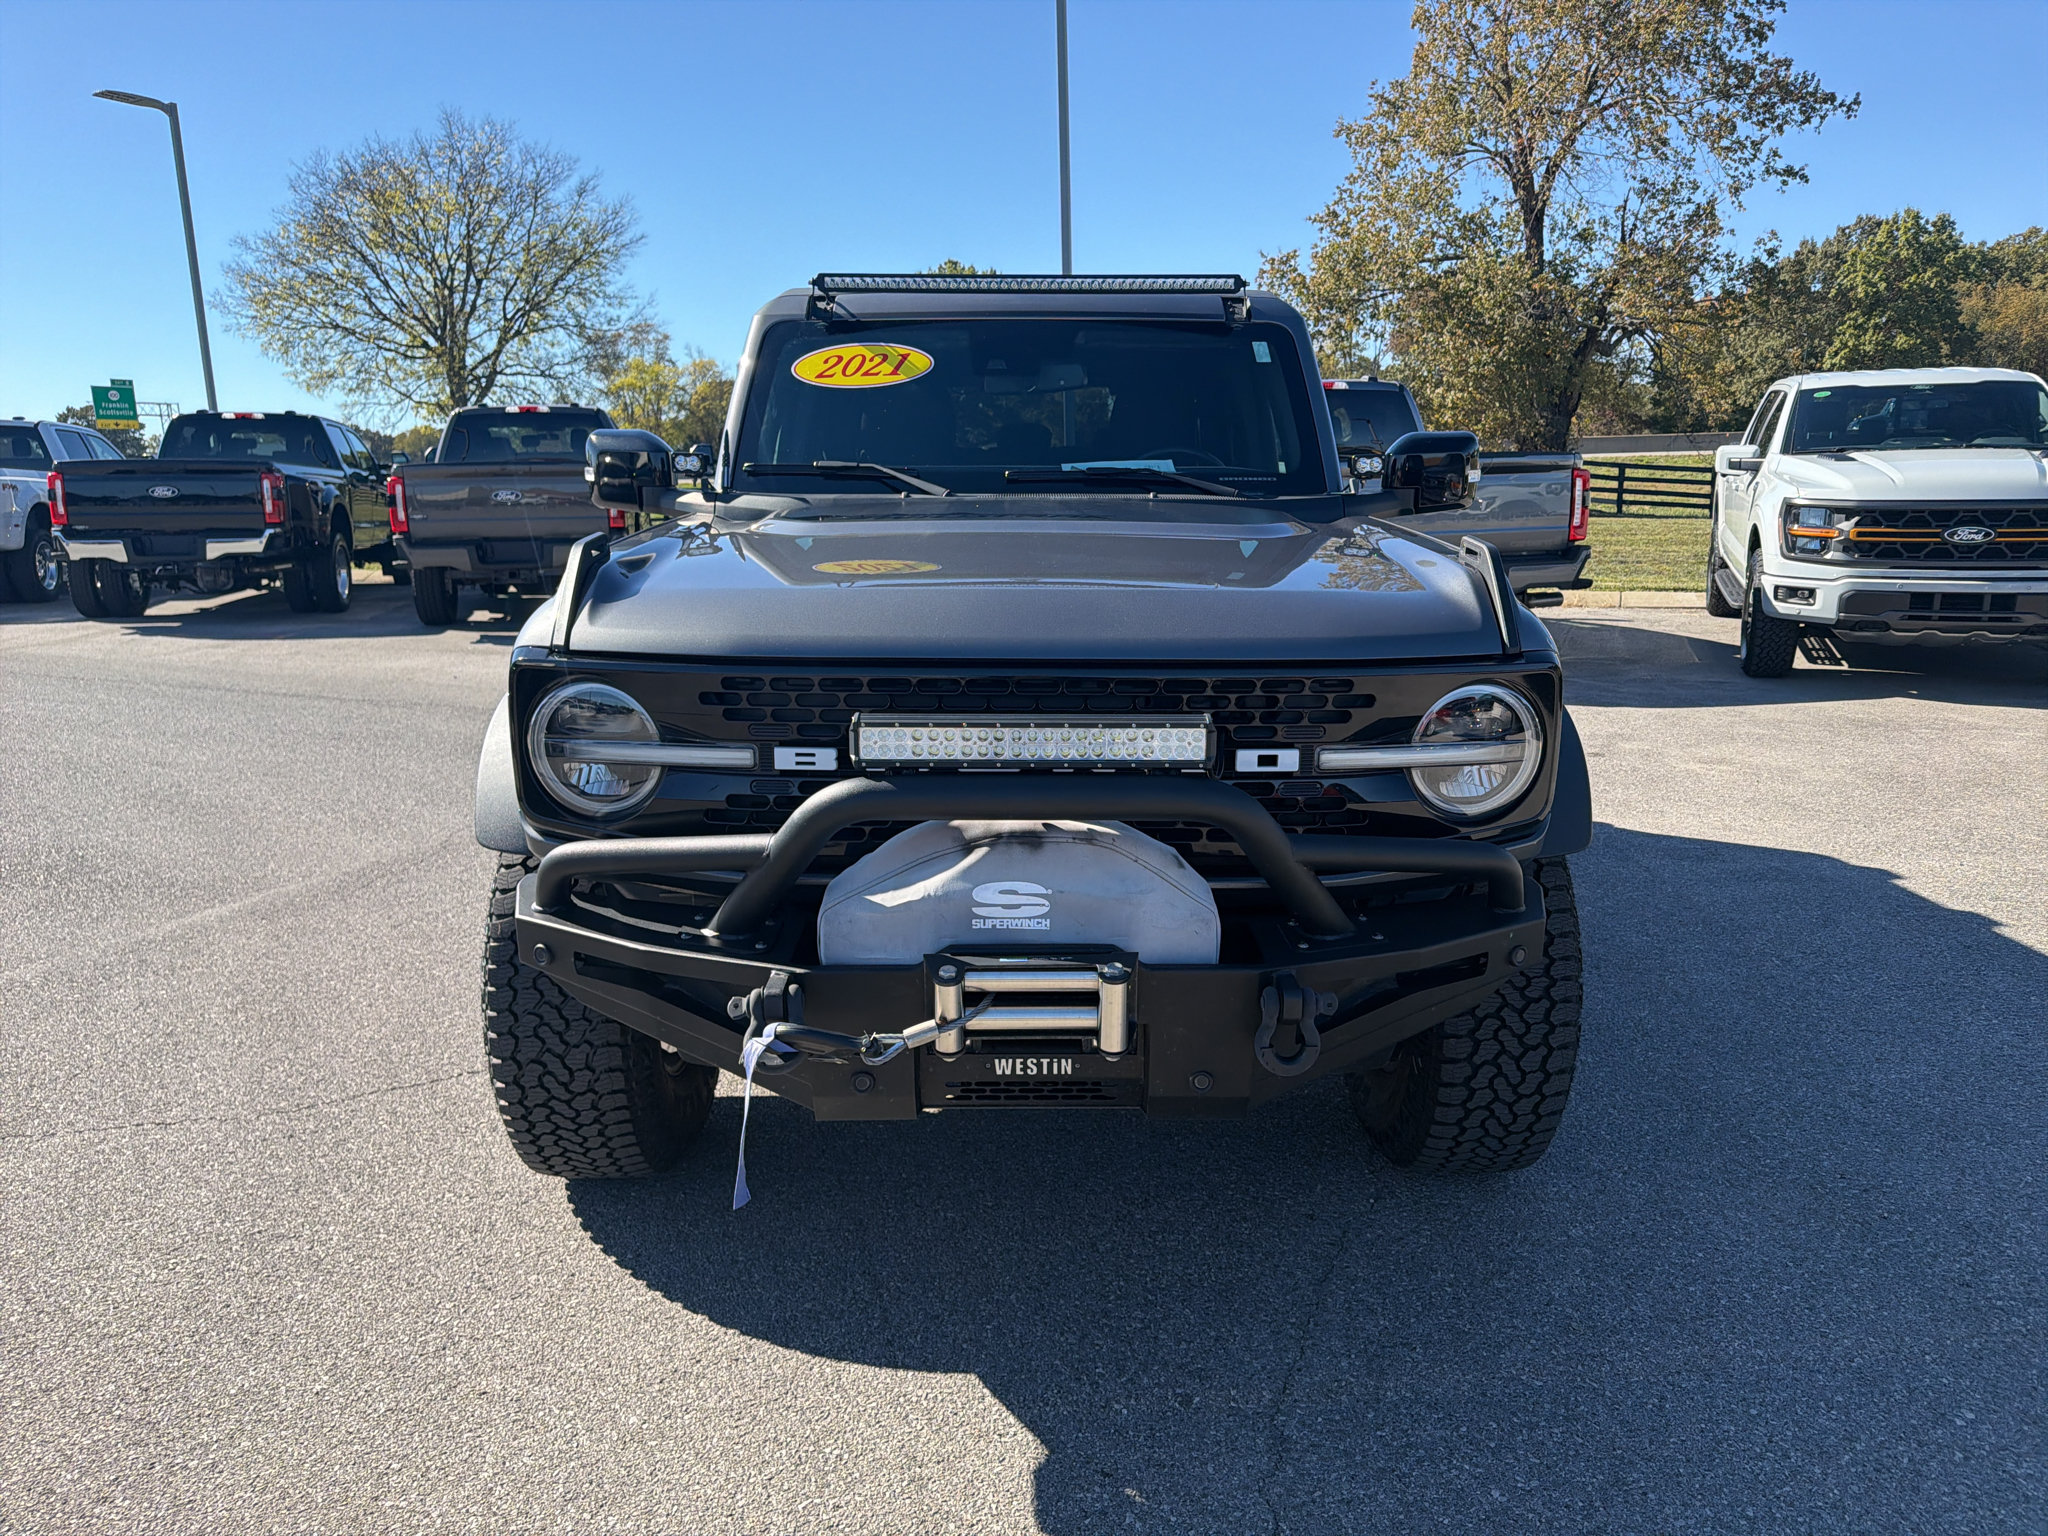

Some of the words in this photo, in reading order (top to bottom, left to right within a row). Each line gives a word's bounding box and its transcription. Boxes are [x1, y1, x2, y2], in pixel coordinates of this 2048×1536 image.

[814, 352, 911, 379] 2021
[1953, 528, 1986, 540] Ford
[972, 918, 1050, 930] SUPERWINCH
